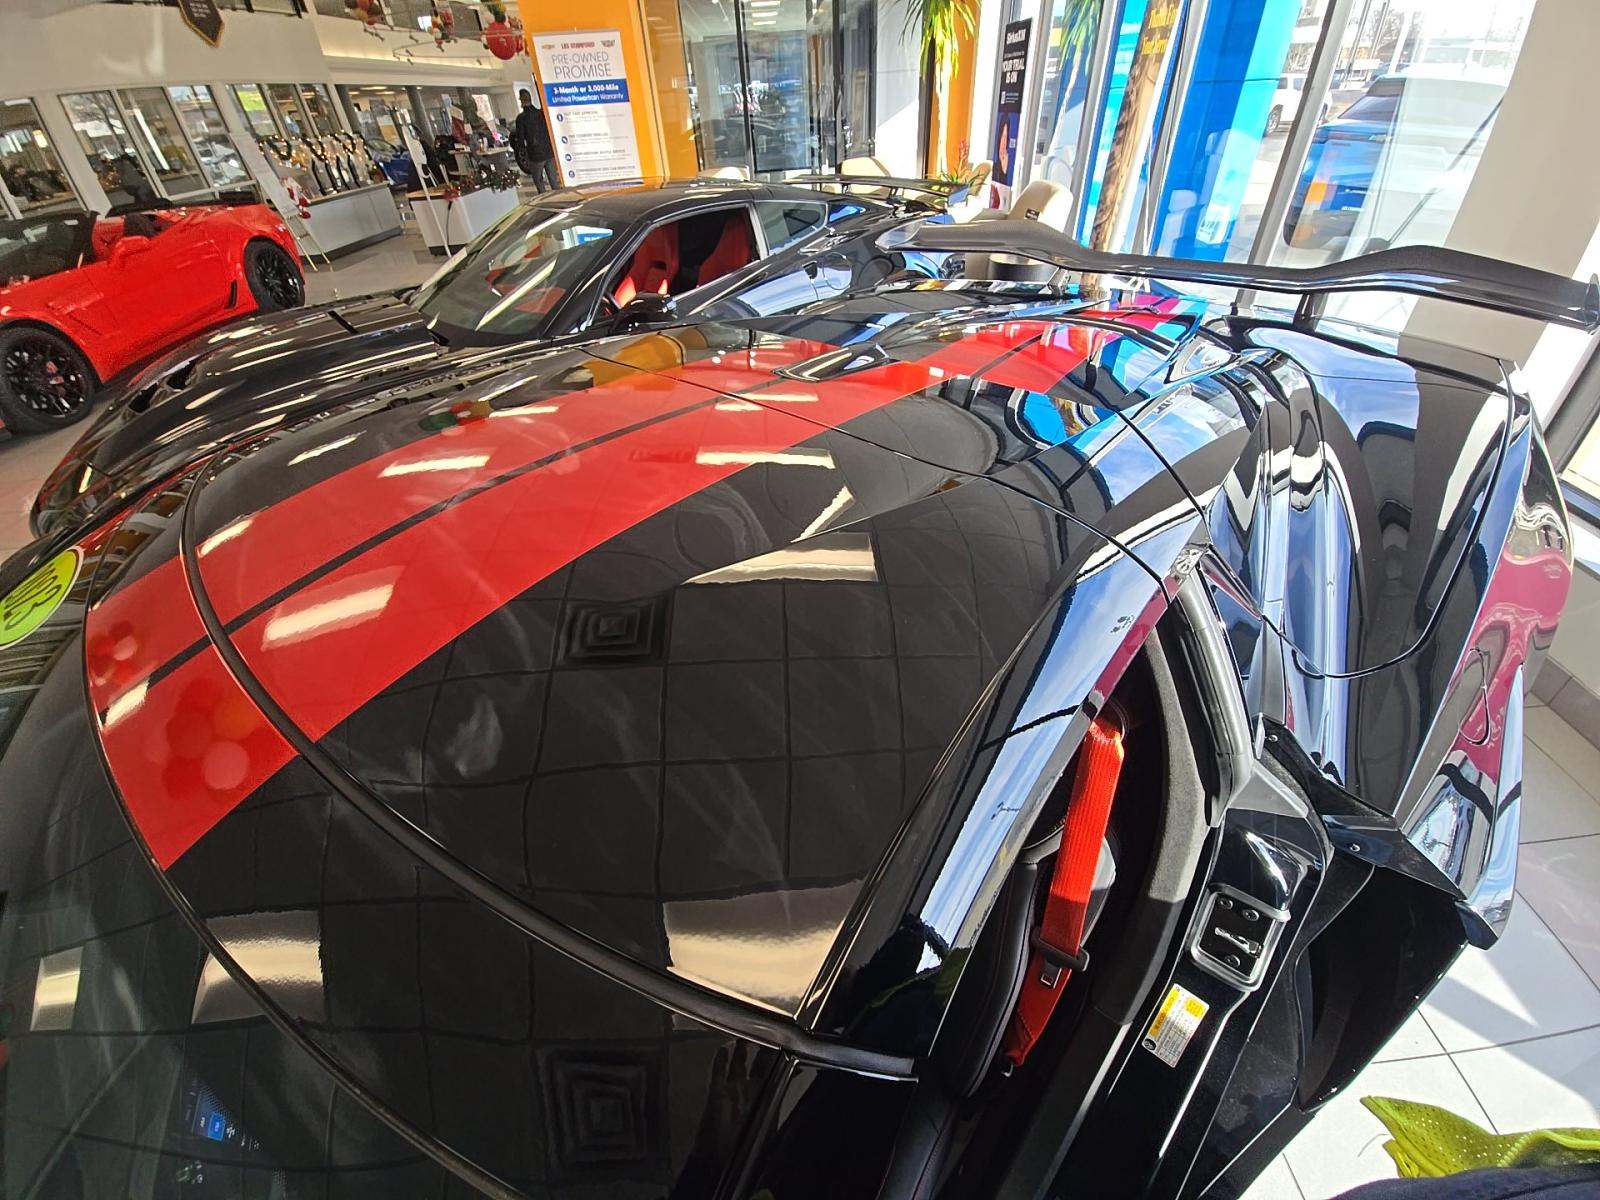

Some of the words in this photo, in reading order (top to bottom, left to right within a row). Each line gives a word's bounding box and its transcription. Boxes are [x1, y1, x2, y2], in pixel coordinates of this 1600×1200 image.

[551, 51, 609, 65] PRE-OWNED
[554, 63, 612, 79] PROMISE
[552, 95, 571, 103] Limited
[572, 94, 599, 102] Powertrain
[600, 93, 624, 101] Warranty
